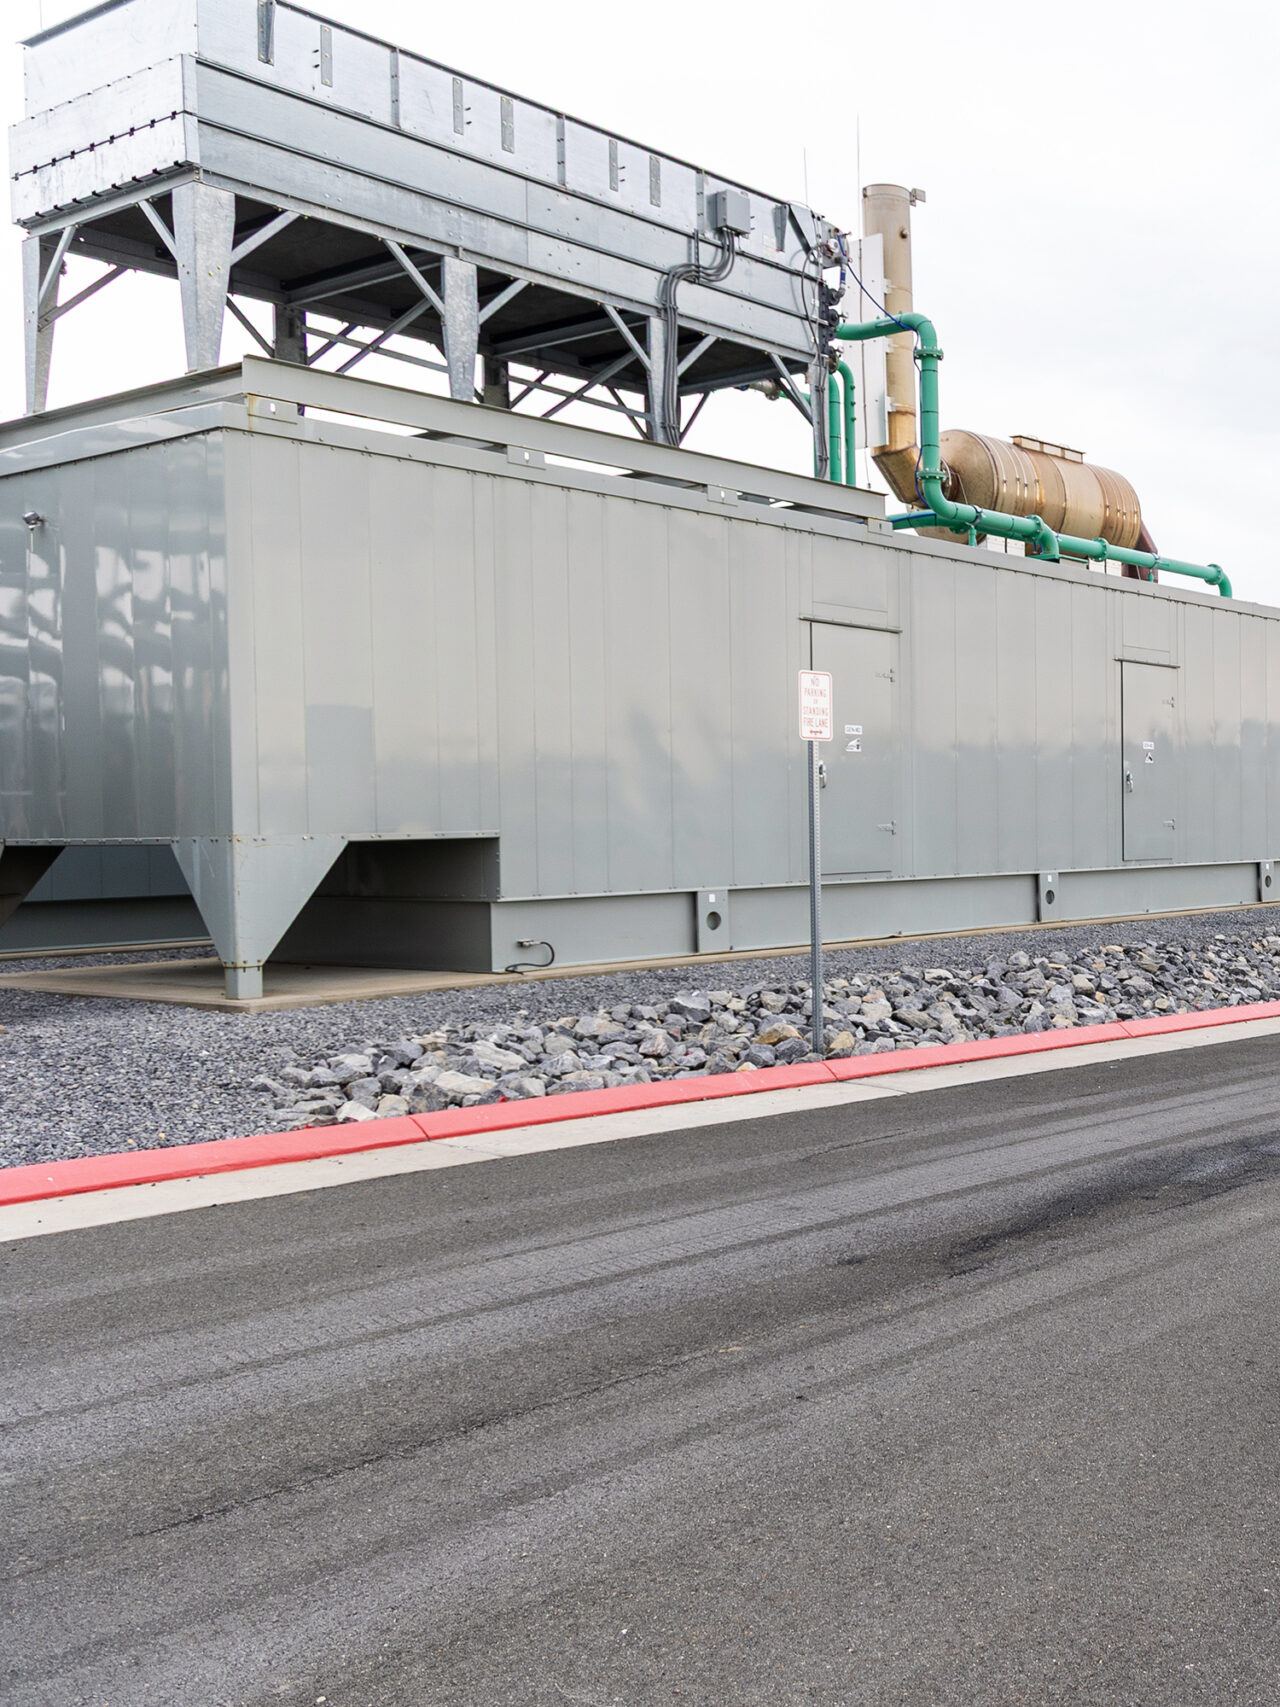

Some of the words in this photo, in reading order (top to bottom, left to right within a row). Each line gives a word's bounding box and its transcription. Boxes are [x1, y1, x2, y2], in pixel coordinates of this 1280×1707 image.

[811, 678, 819, 687] NO
[804, 688, 826, 698] PARKING
[804, 706, 828, 717] STANDING
[804, 717, 813, 727] FIRE
[815, 718, 828, 728] LANE
